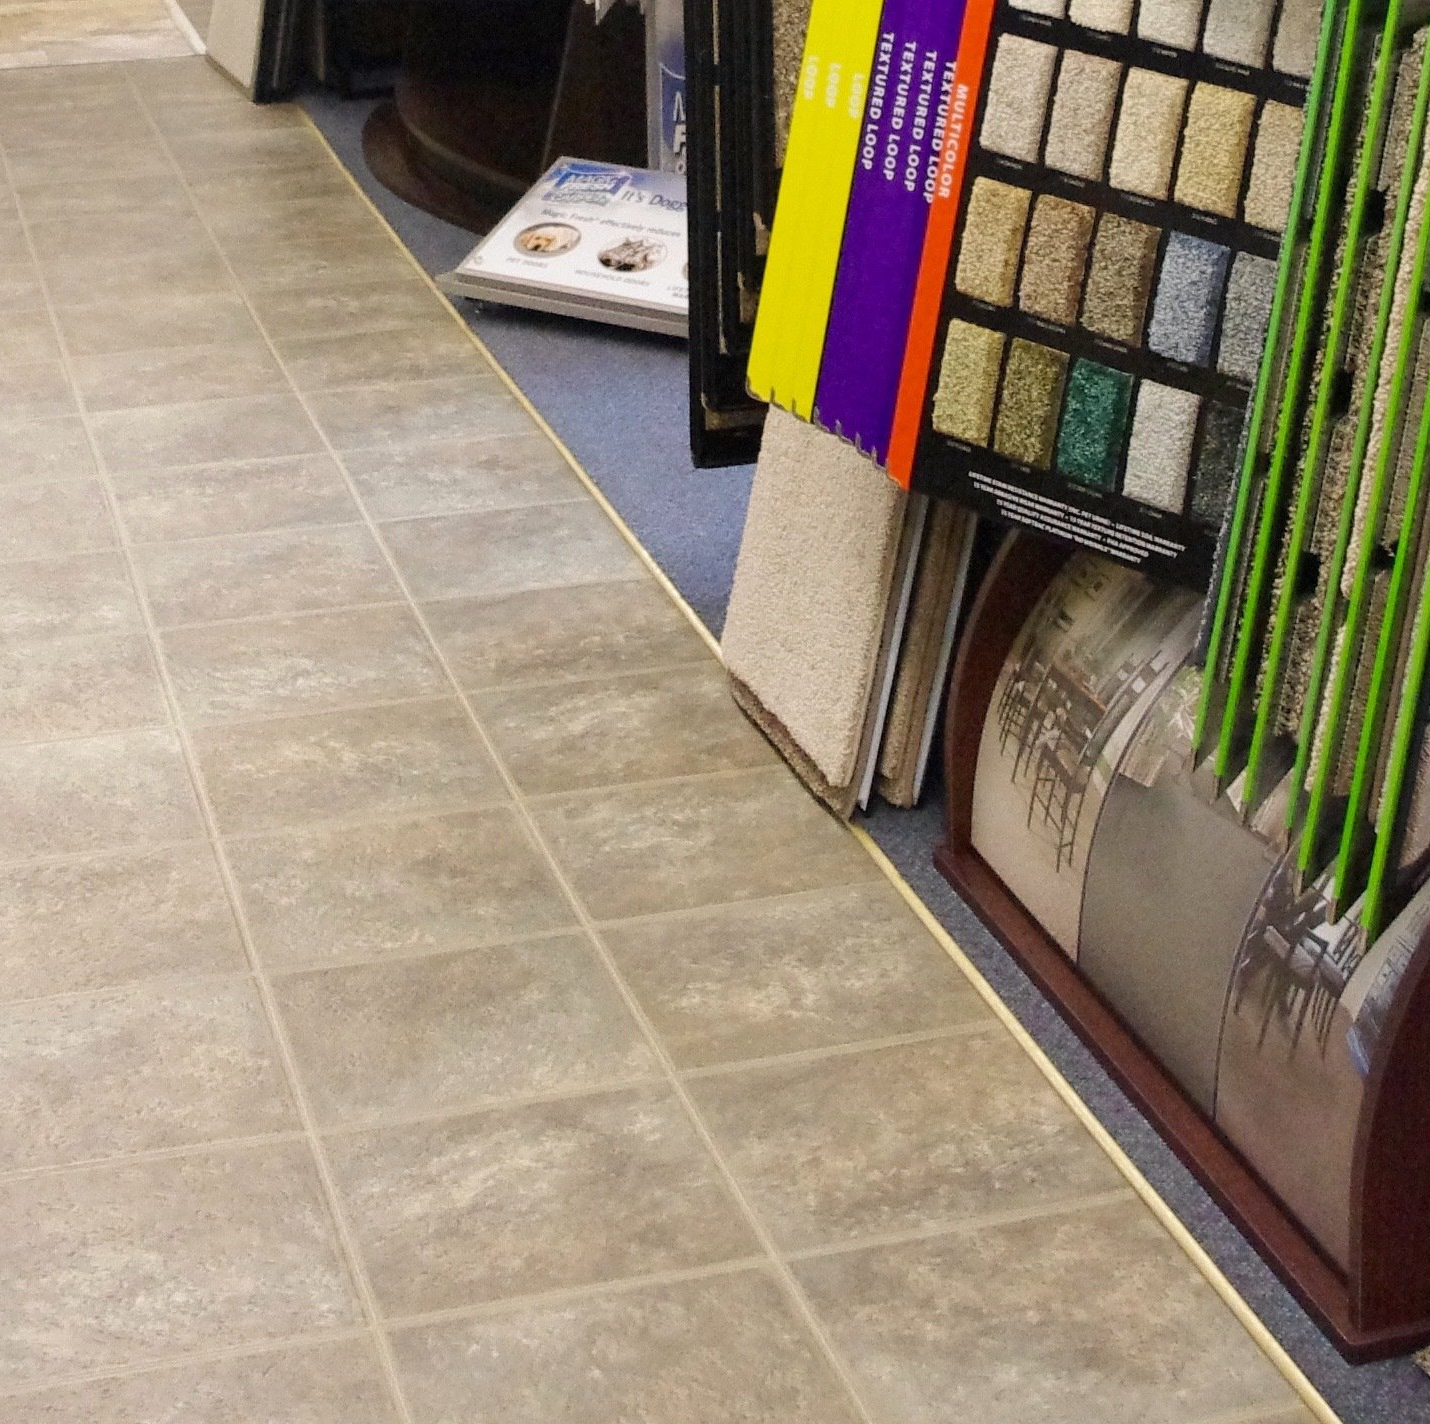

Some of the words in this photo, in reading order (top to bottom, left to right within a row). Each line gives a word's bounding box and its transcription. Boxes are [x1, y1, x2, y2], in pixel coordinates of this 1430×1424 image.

[803, 56, 820, 101] LOOP
[869, 32, 895, 120] TEXTURED
[891, 41, 917, 130] TEXTURED
[912, 50, 938, 140] TEXTURED
[931, 61, 957, 152] TEXTURED
[861, 123, 879, 170] LOOP
[883, 133, 901, 181] LOOP
[938, 84, 969, 199] MULTICOLOR
[904, 144, 921, 192] LOOP
[923, 155, 940, 204] LOOP
[622, 190, 644, 204] It's
